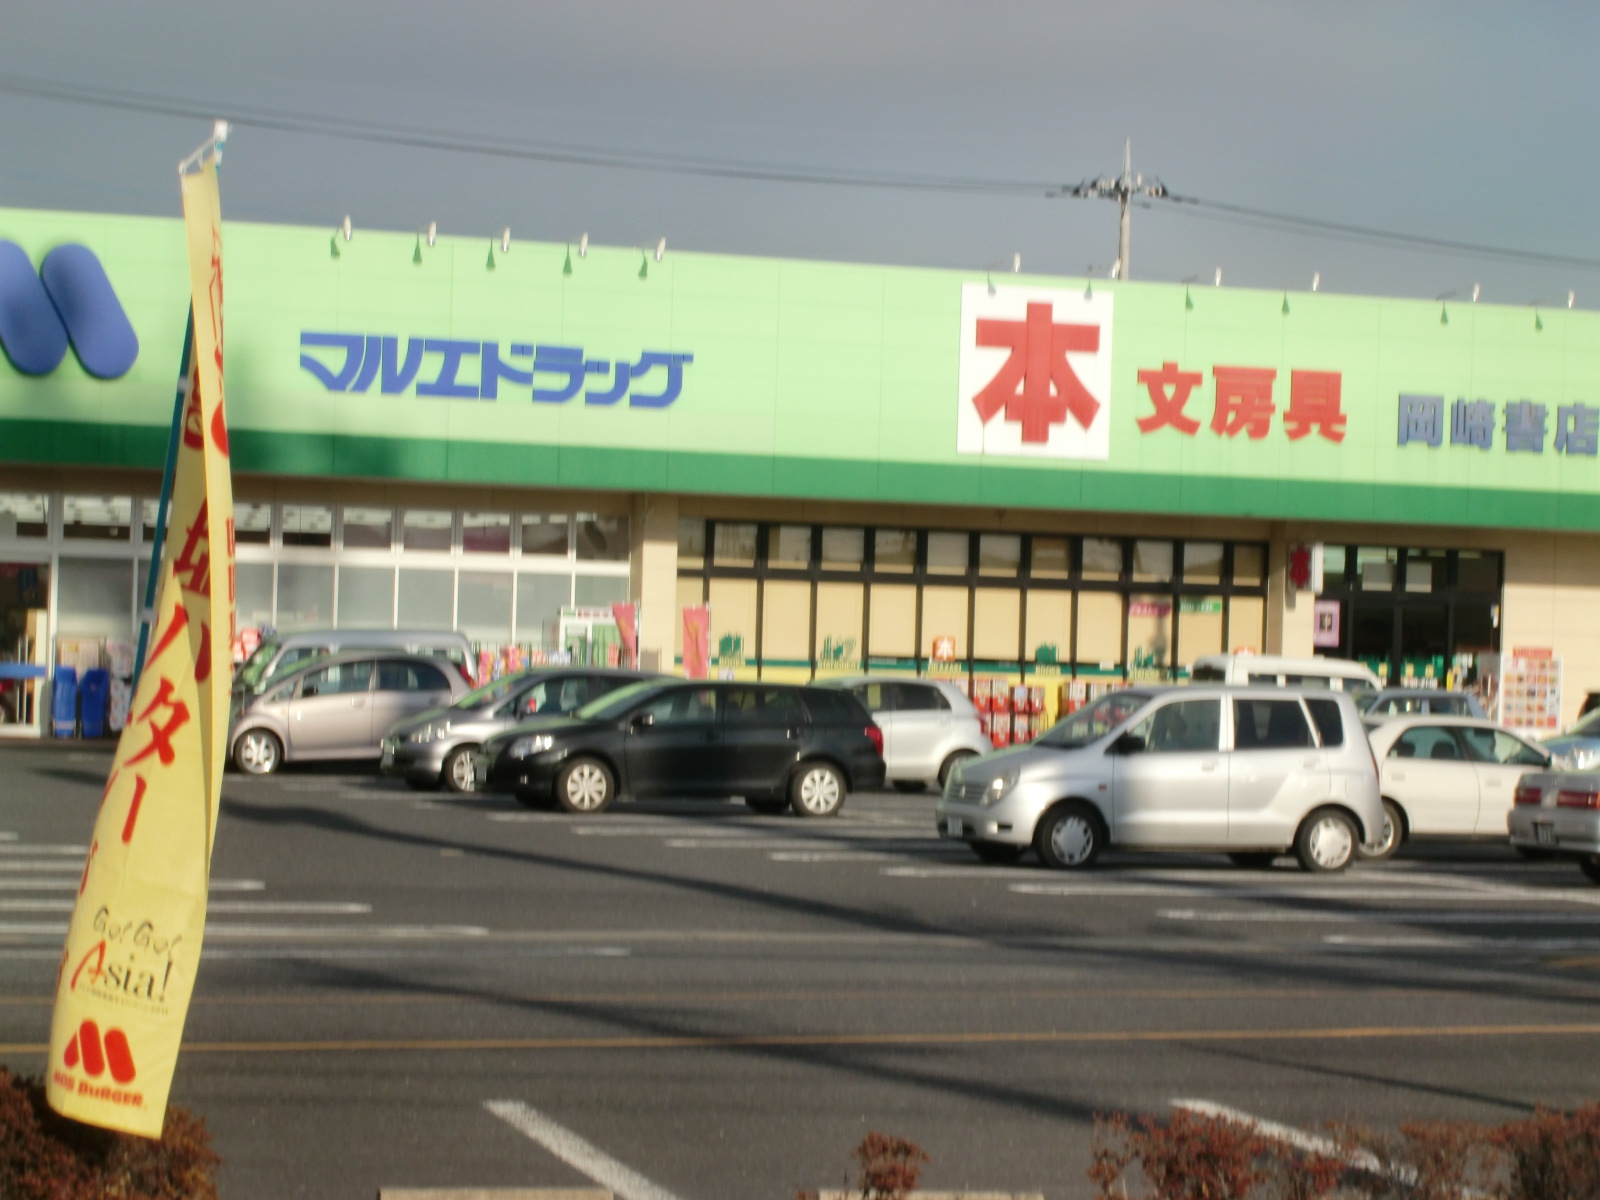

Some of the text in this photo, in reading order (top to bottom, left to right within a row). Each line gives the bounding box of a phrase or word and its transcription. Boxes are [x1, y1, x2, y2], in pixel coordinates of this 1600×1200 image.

[300, 332, 694, 409] マルエドラッグ
[972, 301, 1100, 443] 本
[1136, 361, 1347, 443] 文房具
[1397, 393, 1600, 457] 岡崎書店
[70, 939, 173, 1002] Asia!
